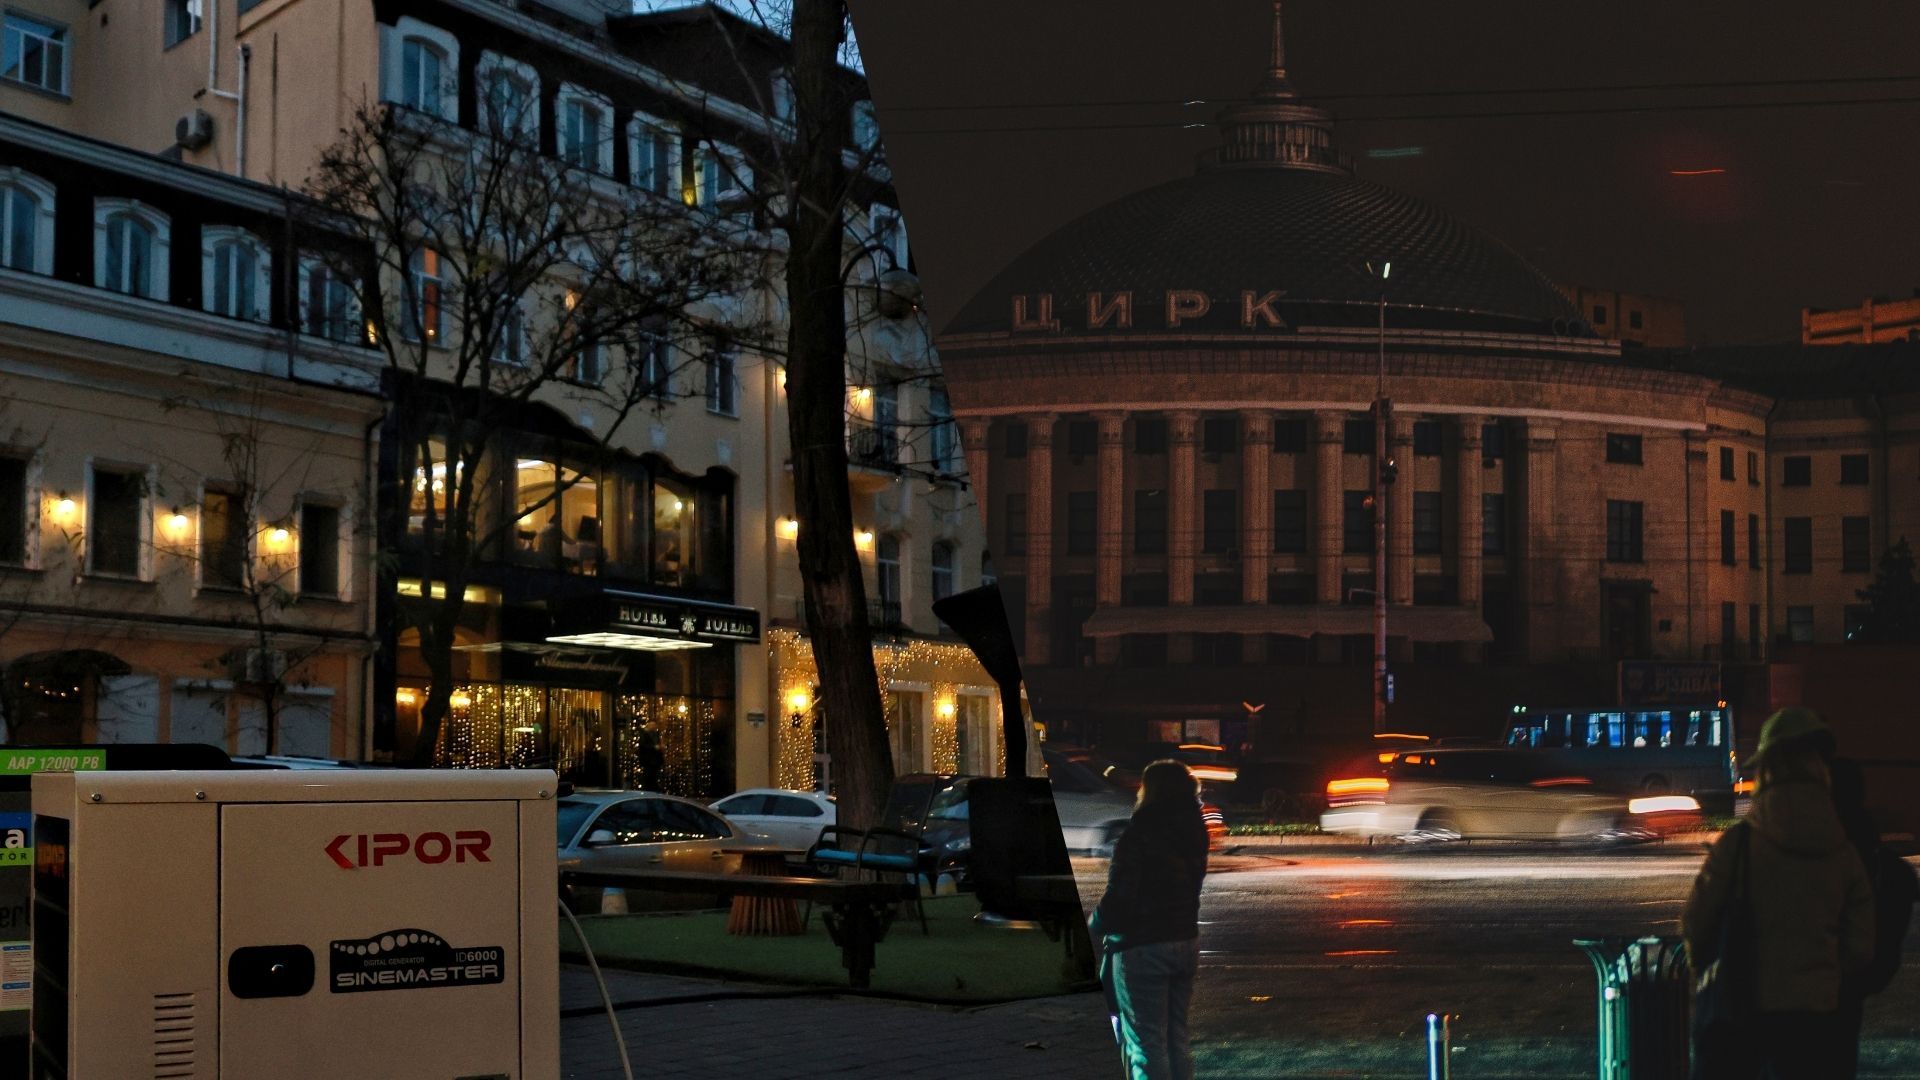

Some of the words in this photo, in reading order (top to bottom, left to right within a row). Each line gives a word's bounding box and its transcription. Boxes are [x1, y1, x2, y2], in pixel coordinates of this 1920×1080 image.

[1012, 290, 1287, 333] ЦИРК
[618, 605, 667, 626] HOTEL
[8, 756, 36, 770] AAP
[40, 756, 79, 770] 12000
[324, 830, 492, 869] KIPOR
[363, 958, 388, 968] DIGITAL
[387, 956, 426, 966] GENERATOR
[455, 950, 498, 964] ID6000
[335, 963, 499, 988] SINEMASTER
